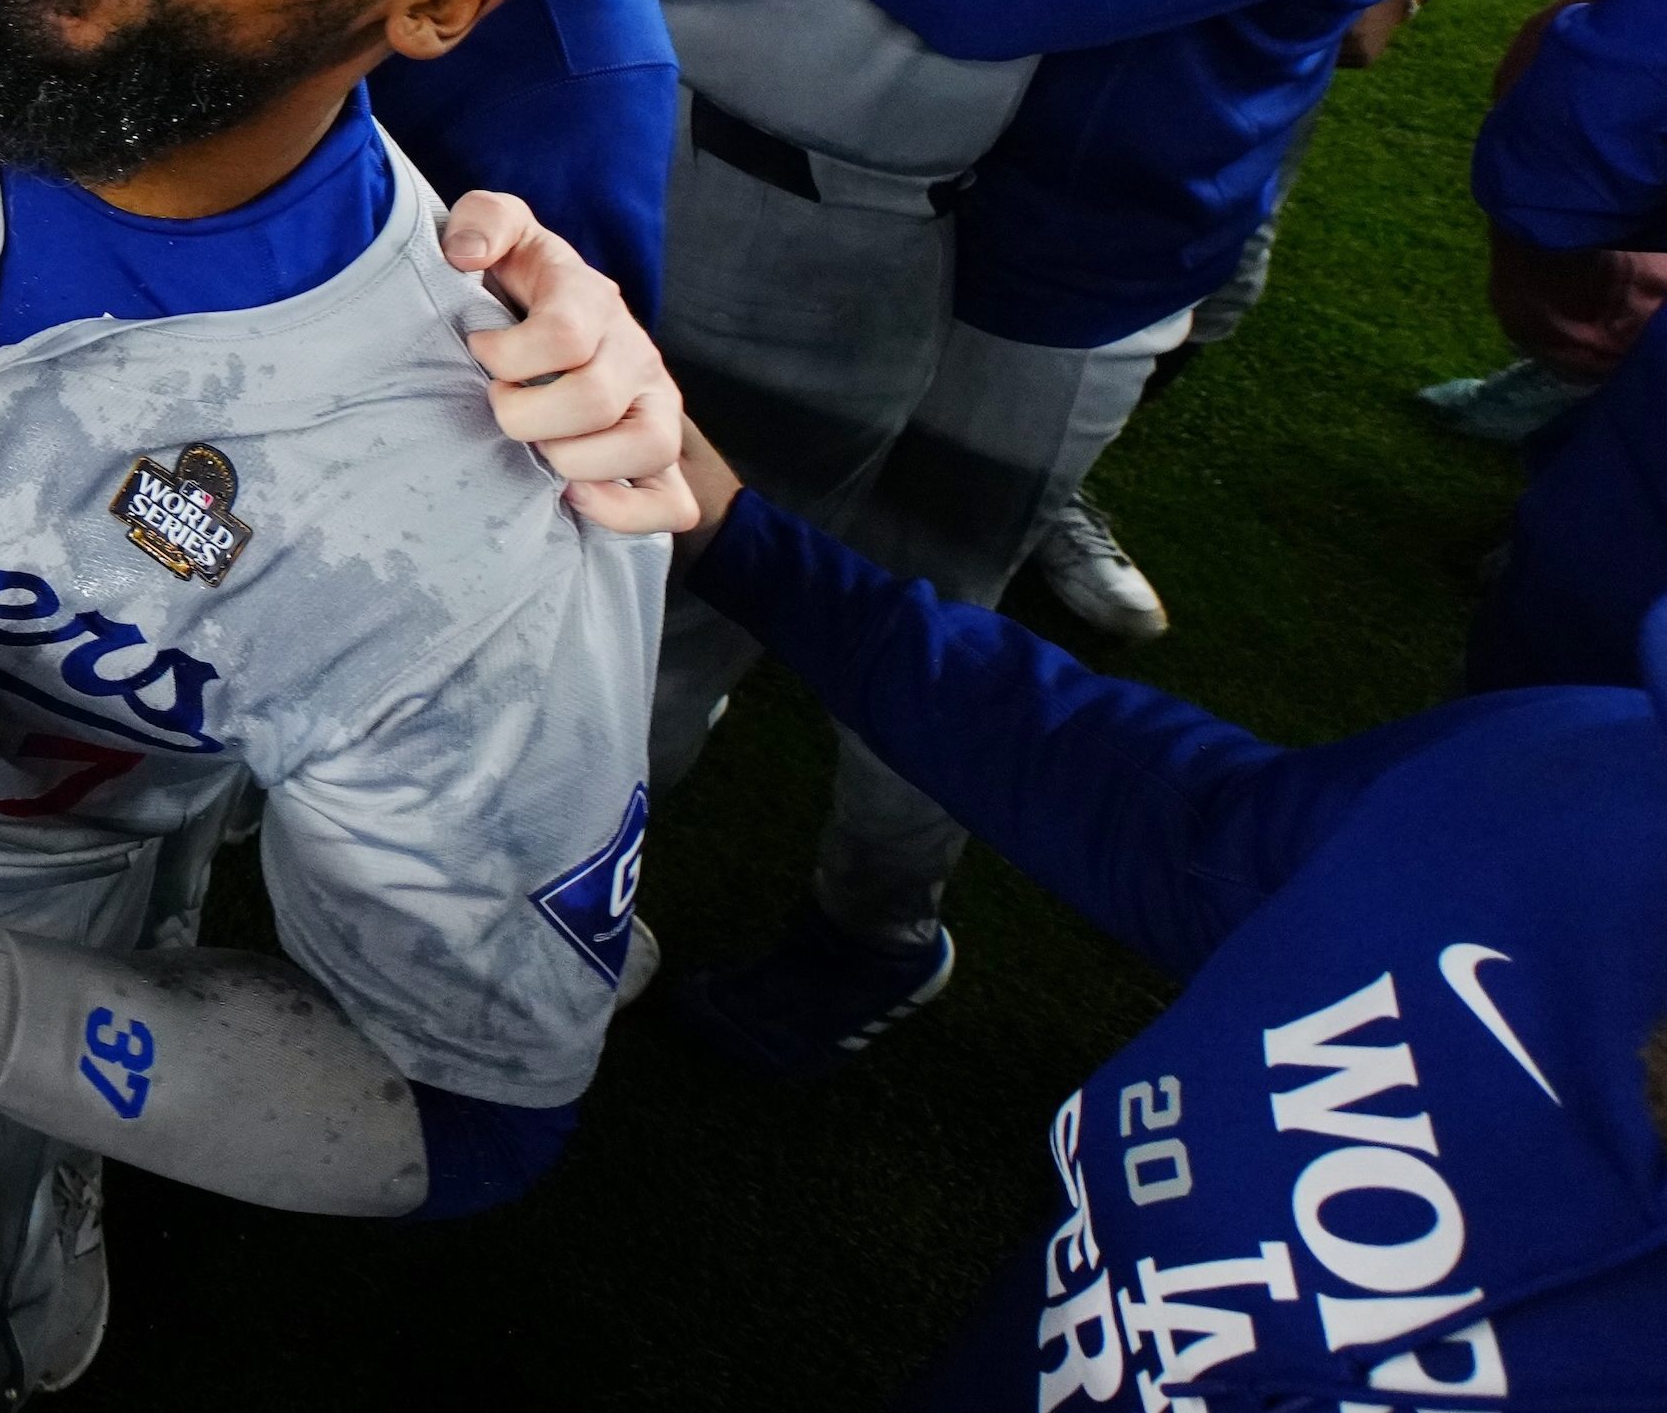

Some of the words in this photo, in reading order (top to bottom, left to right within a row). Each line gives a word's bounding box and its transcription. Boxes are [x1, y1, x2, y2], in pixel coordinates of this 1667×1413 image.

[127, 493, 222, 567] SERIES
[138, 470, 235, 550] WORLD
[78, 1005, 155, 1120] 37
[1119, 1075, 1193, 1207] 20
[1264, 971, 1508, 1413] WOR
